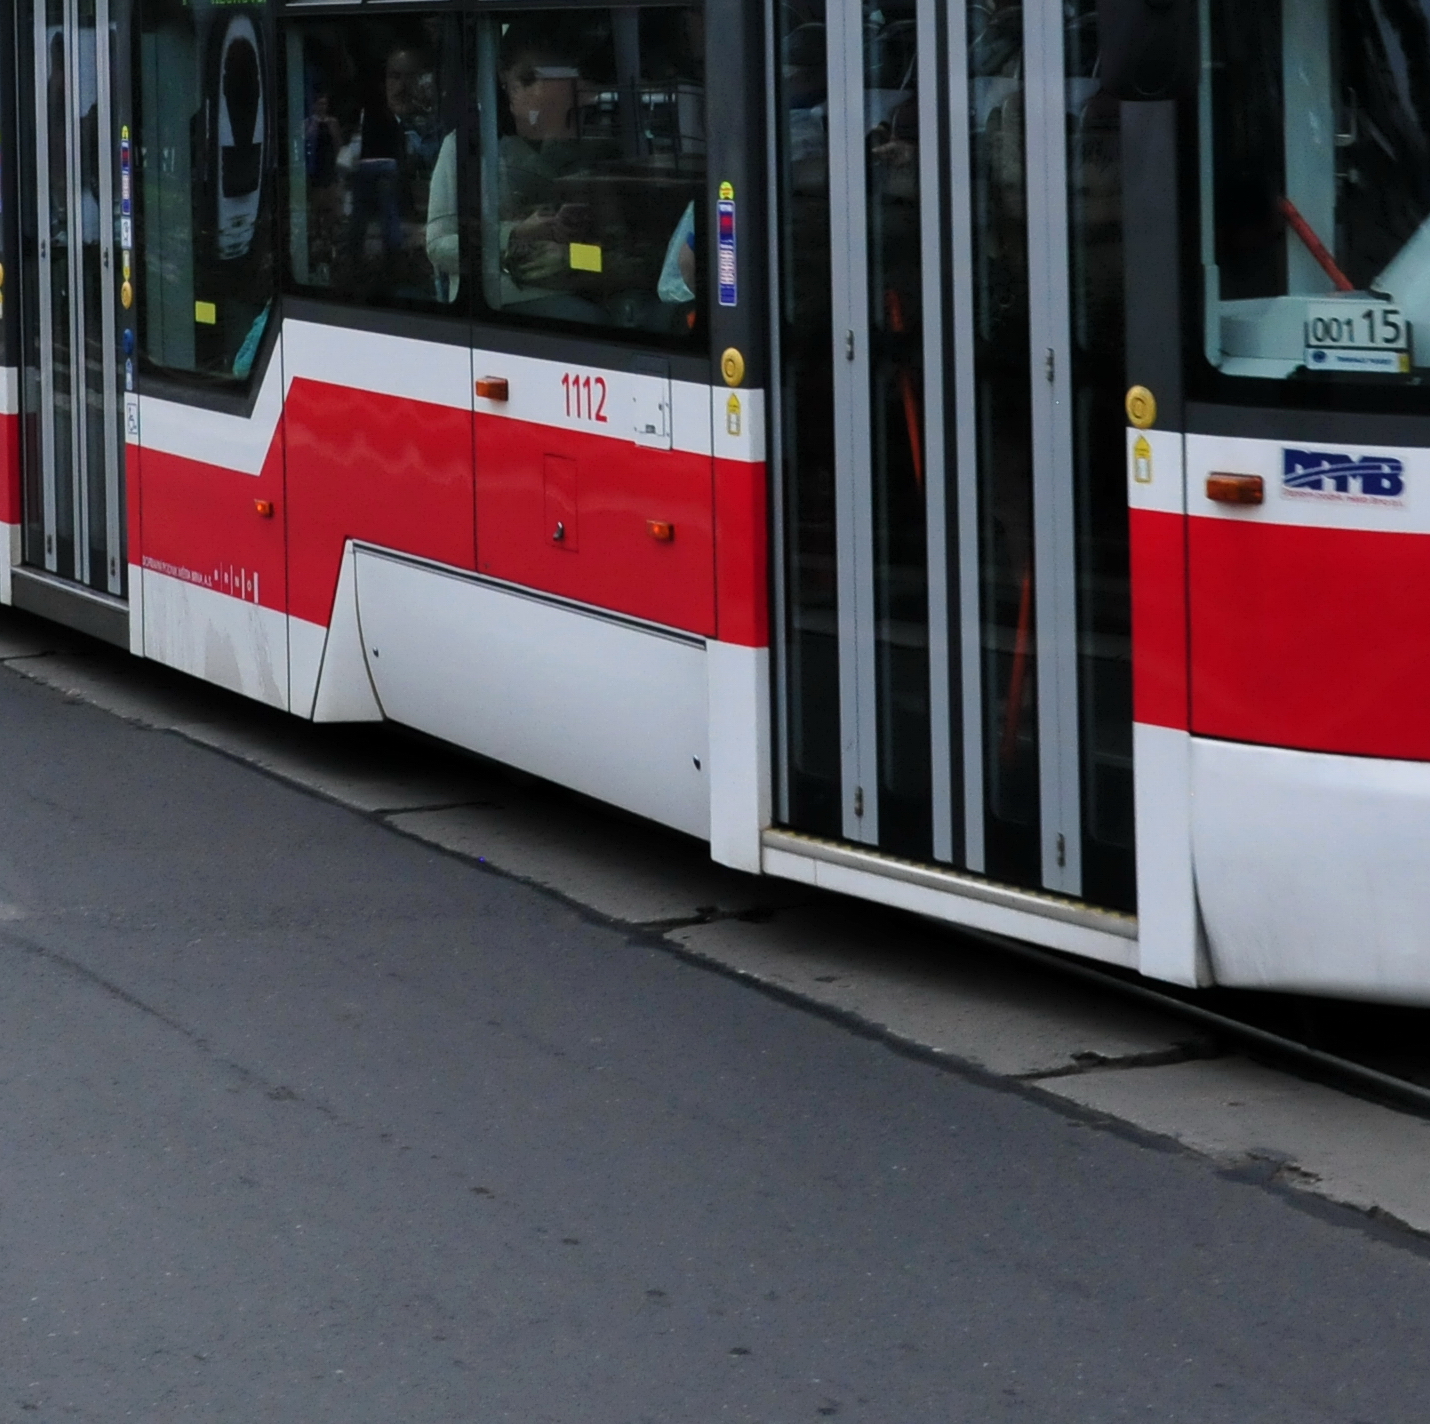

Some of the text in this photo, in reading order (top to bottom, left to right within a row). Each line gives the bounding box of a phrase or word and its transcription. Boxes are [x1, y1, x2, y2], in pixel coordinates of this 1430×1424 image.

[1312, 309, 1401, 344] 001 15
[561, 372, 608, 423] 1112
